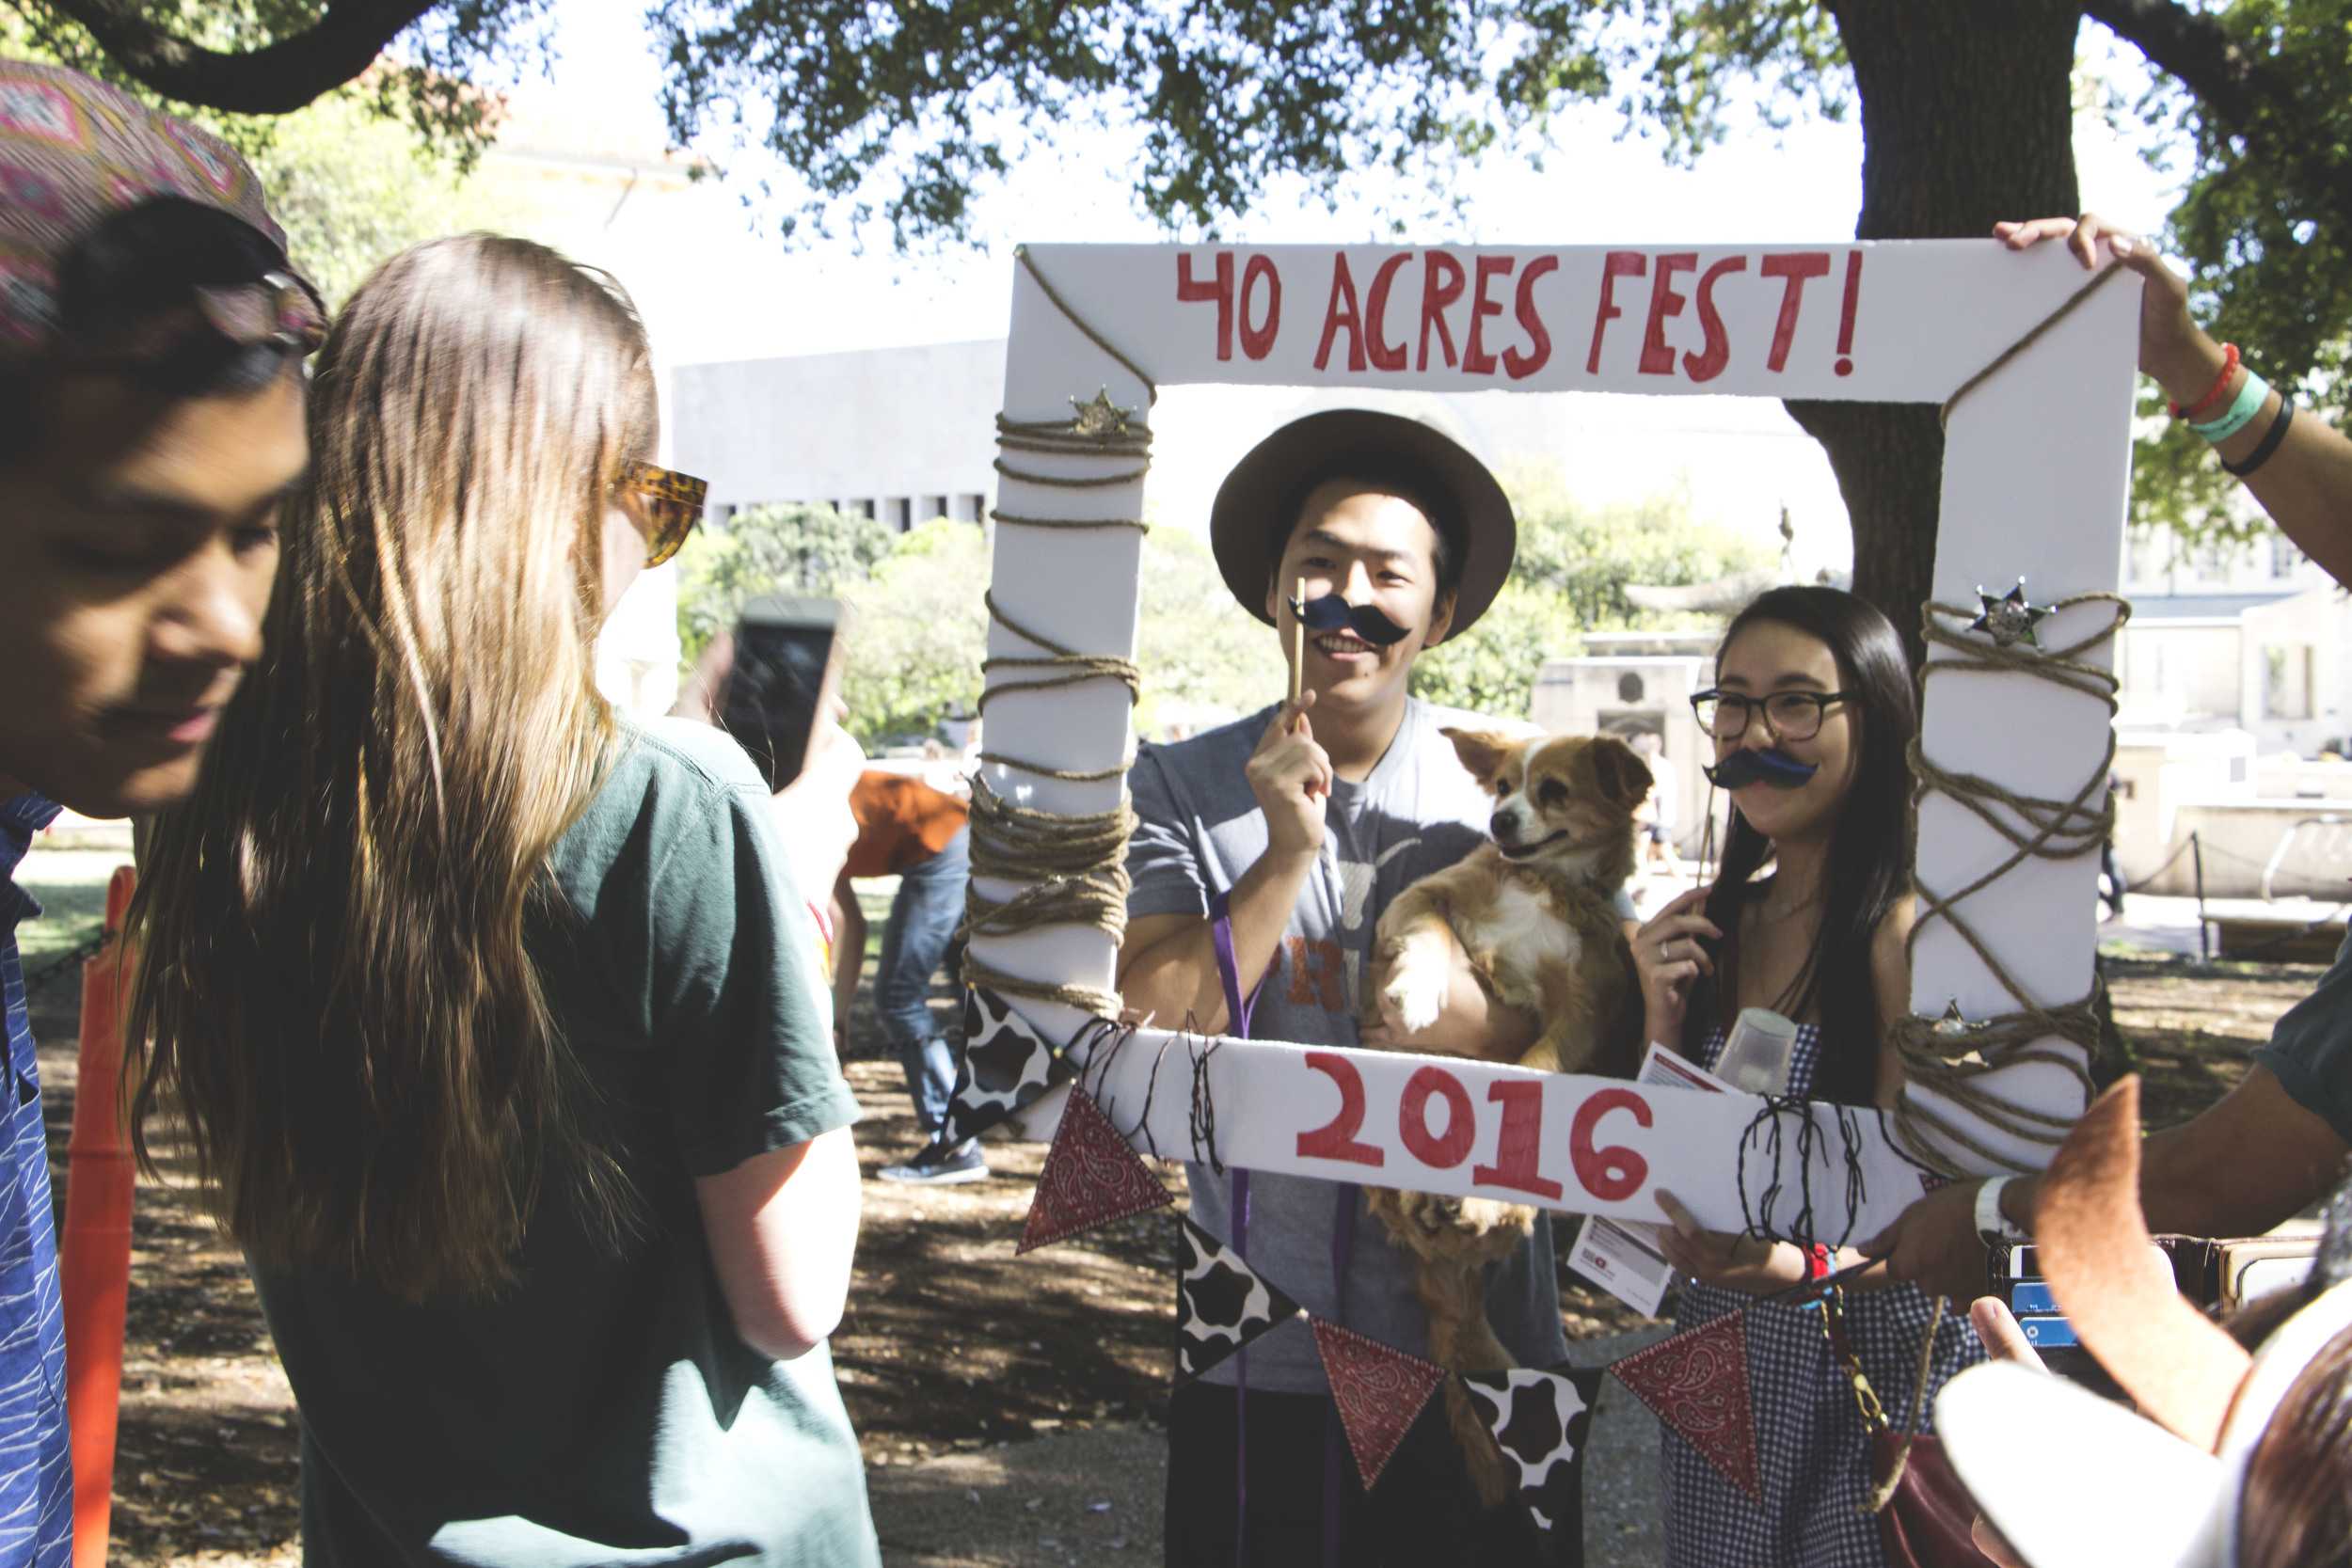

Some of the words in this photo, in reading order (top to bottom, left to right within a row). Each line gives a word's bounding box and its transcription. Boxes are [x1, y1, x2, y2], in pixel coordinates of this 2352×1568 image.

[1177, 252, 1280, 361] 40
[1313, 250, 1558, 380] ACRES
[1587, 251, 1863, 382] FEST!
[1296, 1052, 1653, 1201] 2016
